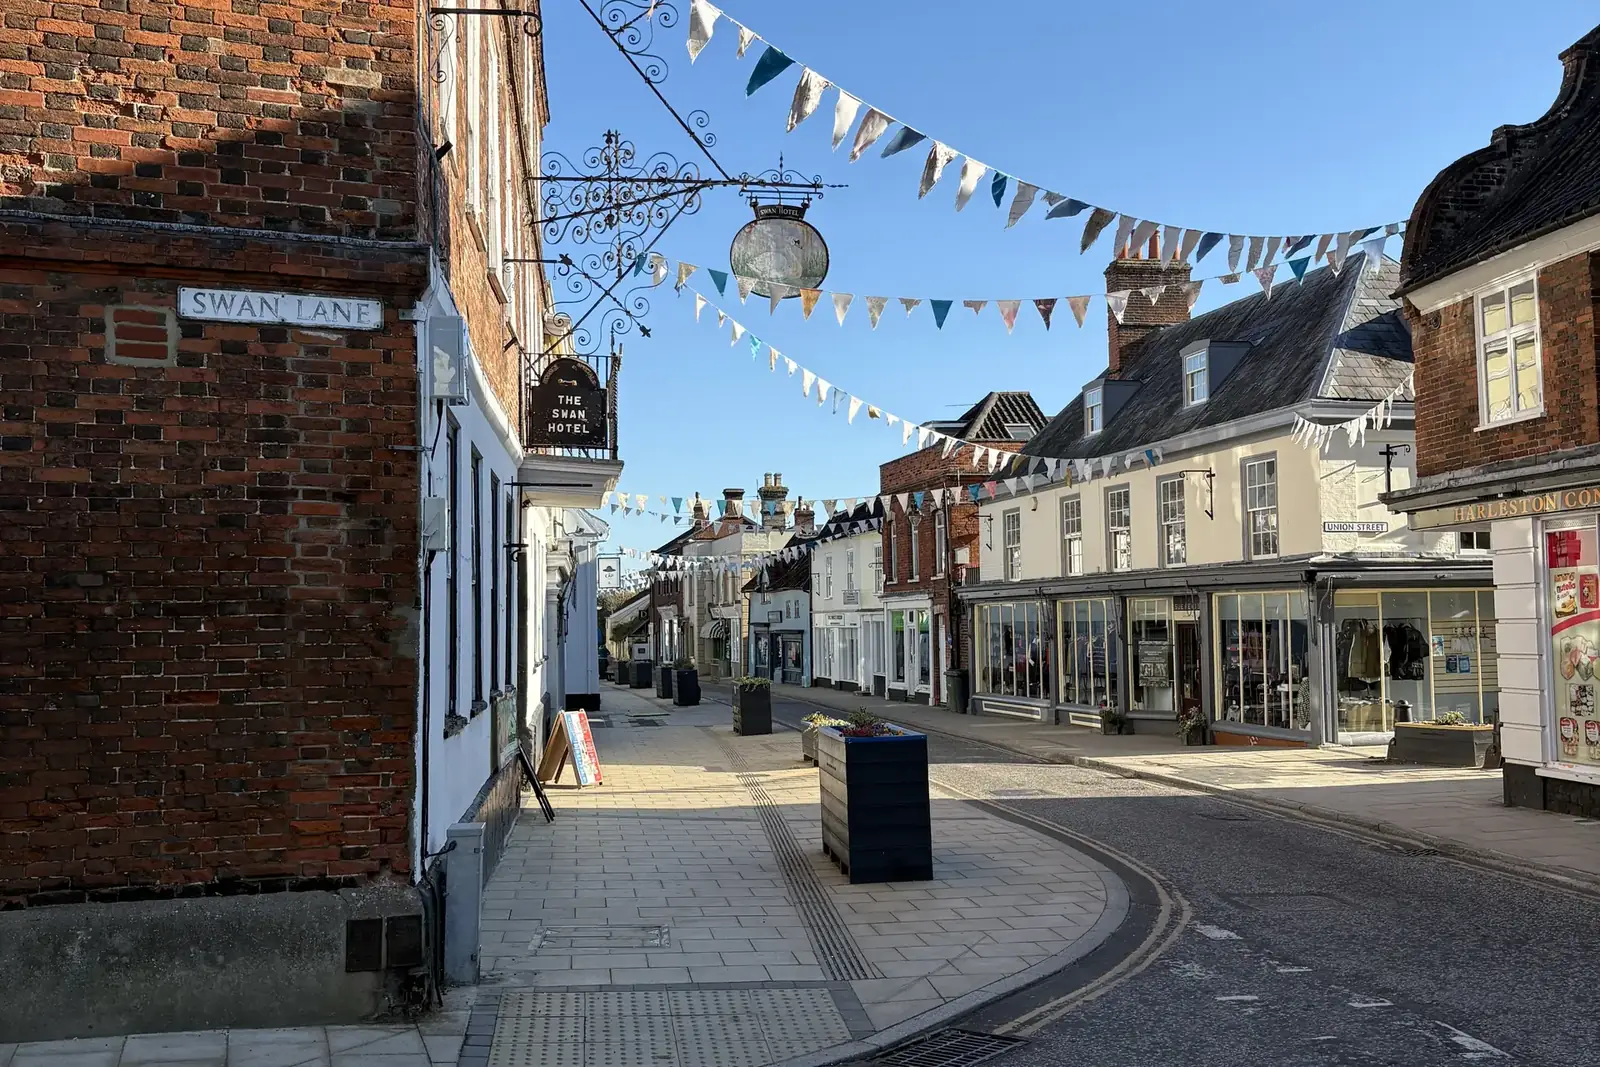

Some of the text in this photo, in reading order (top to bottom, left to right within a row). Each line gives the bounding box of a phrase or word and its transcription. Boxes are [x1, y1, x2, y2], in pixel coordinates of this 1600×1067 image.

[760, 207, 800, 217] SWAN HOTEL
[192, 291, 371, 325] SWAN LANE
[557, 395, 582, 406] THE
[552, 408, 586, 419] SWAN
[547, 422, 590, 434] HOTEL
[1453, 492, 1558, 522] HARLESTON
[1327, 523, 1385, 531] UNION STREET
